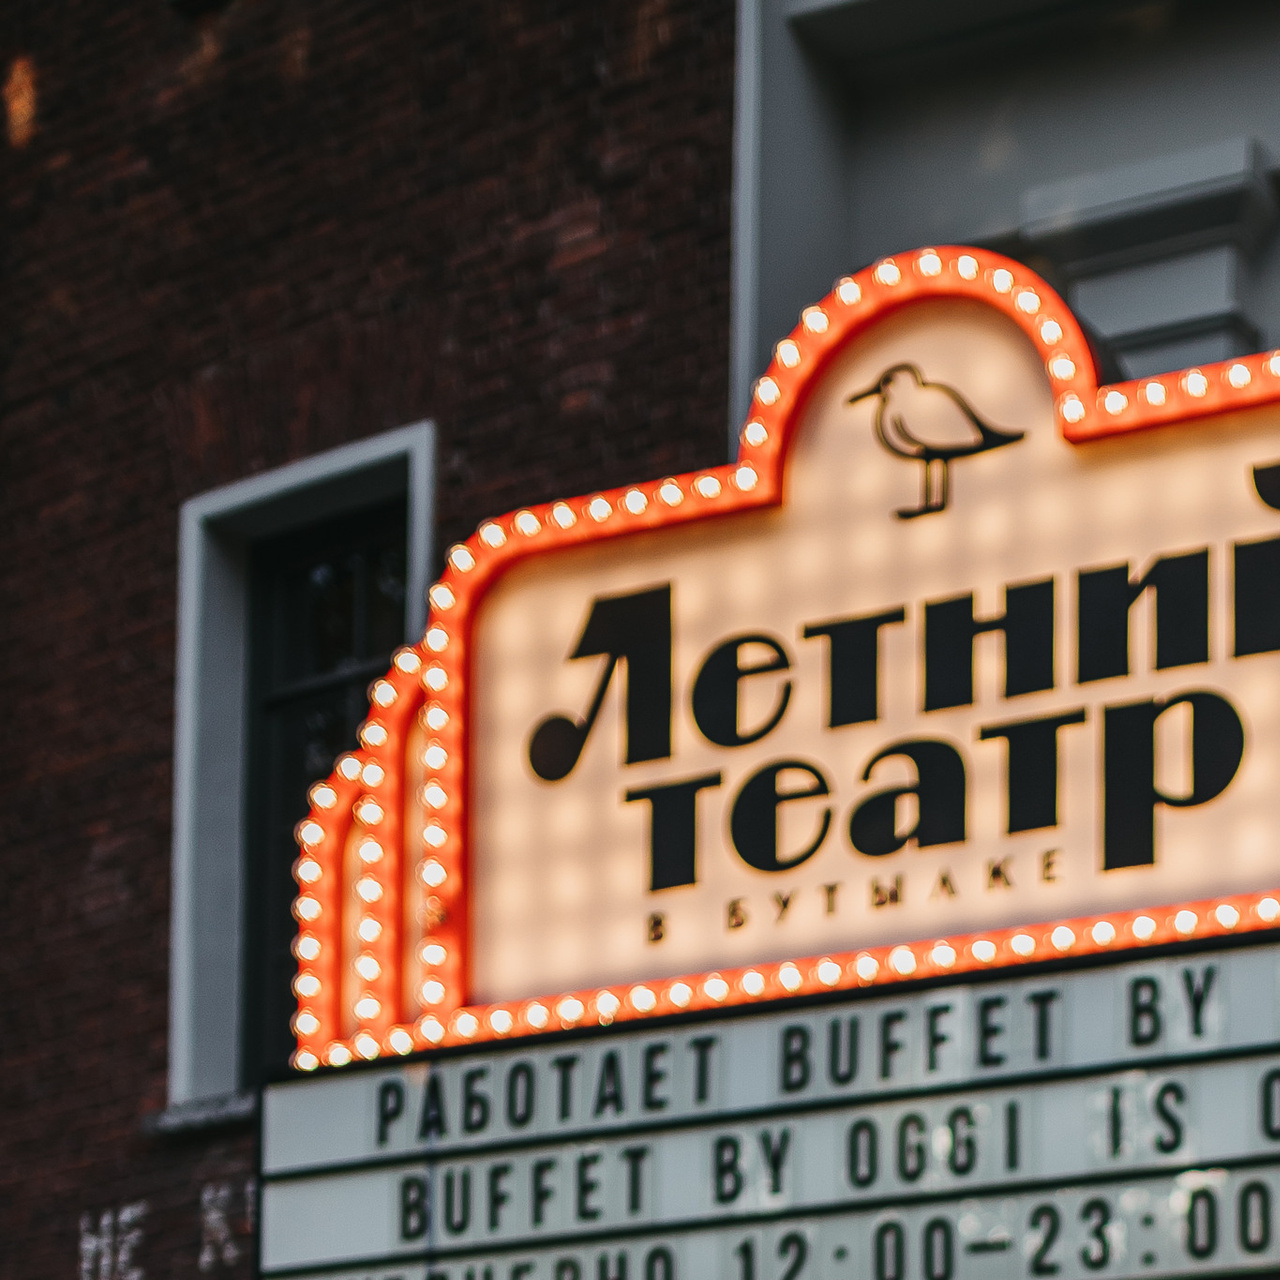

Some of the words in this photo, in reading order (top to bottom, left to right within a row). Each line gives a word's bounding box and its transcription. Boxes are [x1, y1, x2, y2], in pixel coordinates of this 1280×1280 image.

[624, 691, 1246, 893] театр
[647, 914, 664, 943] В
[727, 848, 1064, 931] БУТЫЛКЕ
[376, 1037, 721, 1146] РАБОТАЕТ
[781, 989, 1061, 1093] BUFFET
[1129, 966, 1218, 1049] BY
[400, 1146, 651, 1243] BUFFET
[714, 1128, 791, 1205] BY
[847, 1100, 1021, 1189] OGGI
[1106, 1082, 1186, 1158] IS
